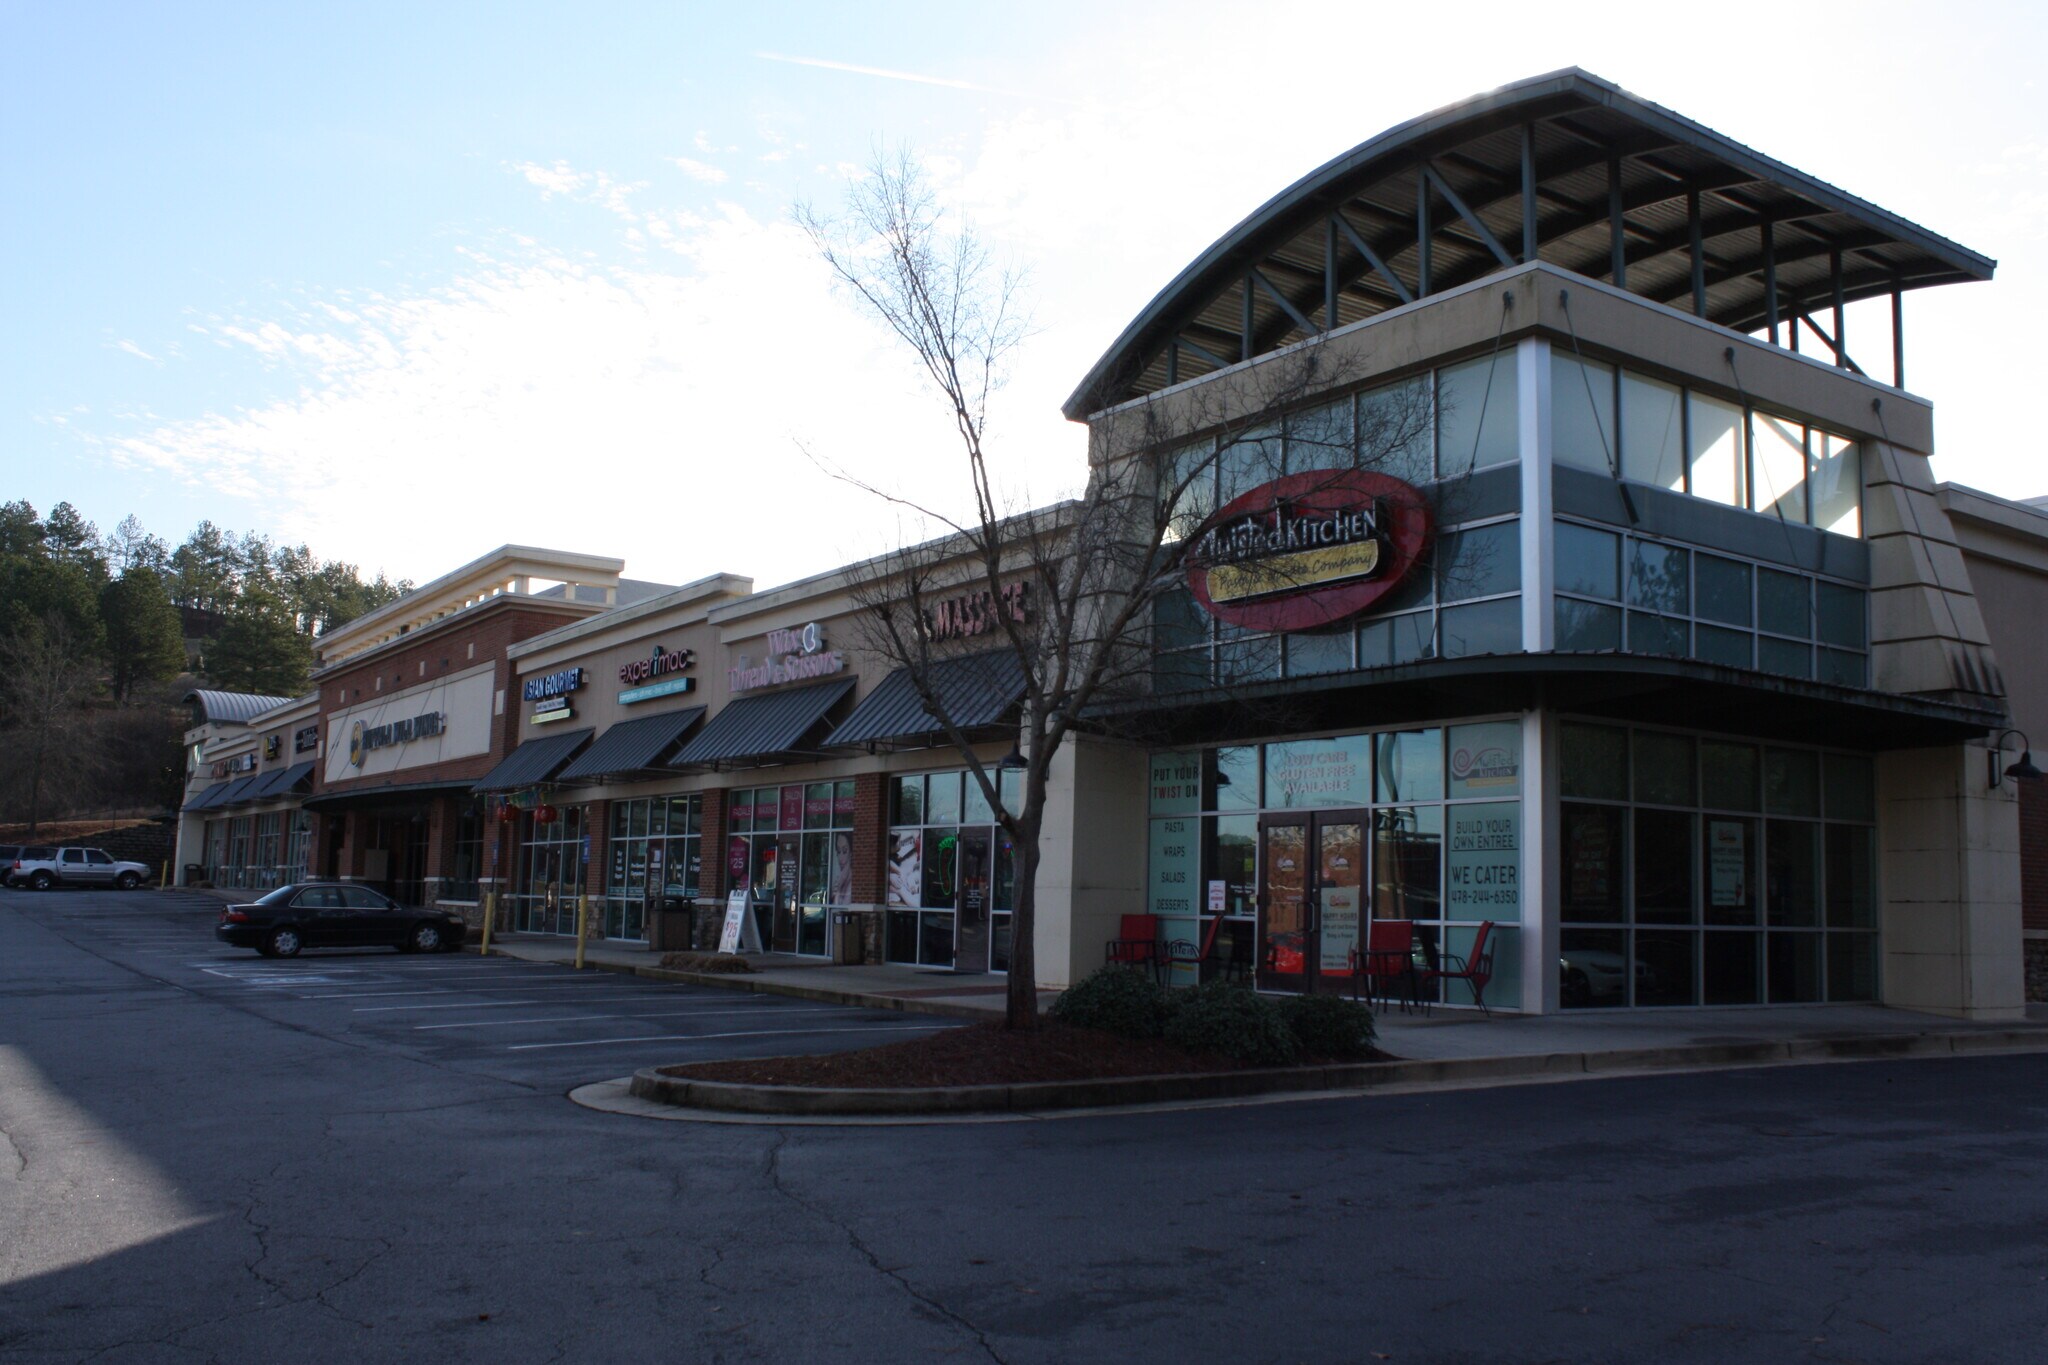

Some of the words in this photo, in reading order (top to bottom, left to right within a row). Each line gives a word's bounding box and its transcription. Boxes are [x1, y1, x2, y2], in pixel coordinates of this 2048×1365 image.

[1312, 554, 1372, 575] Company
[1317, 751, 1347, 764] CARB
[1154, 767, 1171, 782] PUT
[1175, 766, 1199, 781] YOUR
[1280, 767, 1324, 781] GLUTEN
[1327, 764, 1356, 778] FREE
[1154, 786, 1181, 799] TWIST
[1186, 785, 1198, 798] ON
[1285, 780, 1350, 794] AVAILABLE
[1165, 821, 1184, 833] PASTA
[1456, 820, 1483, 834] BUILD
[1486, 819, 1511, 833] YOUR
[1453, 836, 1473, 849] OWN
[1477, 834, 1514, 849] ENTREE
[1163, 846, 1185, 858] WRAPS
[1161, 872, 1186, 883] SALADS
[1451, 866, 1470, 885] WE
[1475, 865, 1517, 885] CATER
[1451, 889, 1518, 904] 478-244-6350
[1156, 899, 1189, 911] DESSERTS
